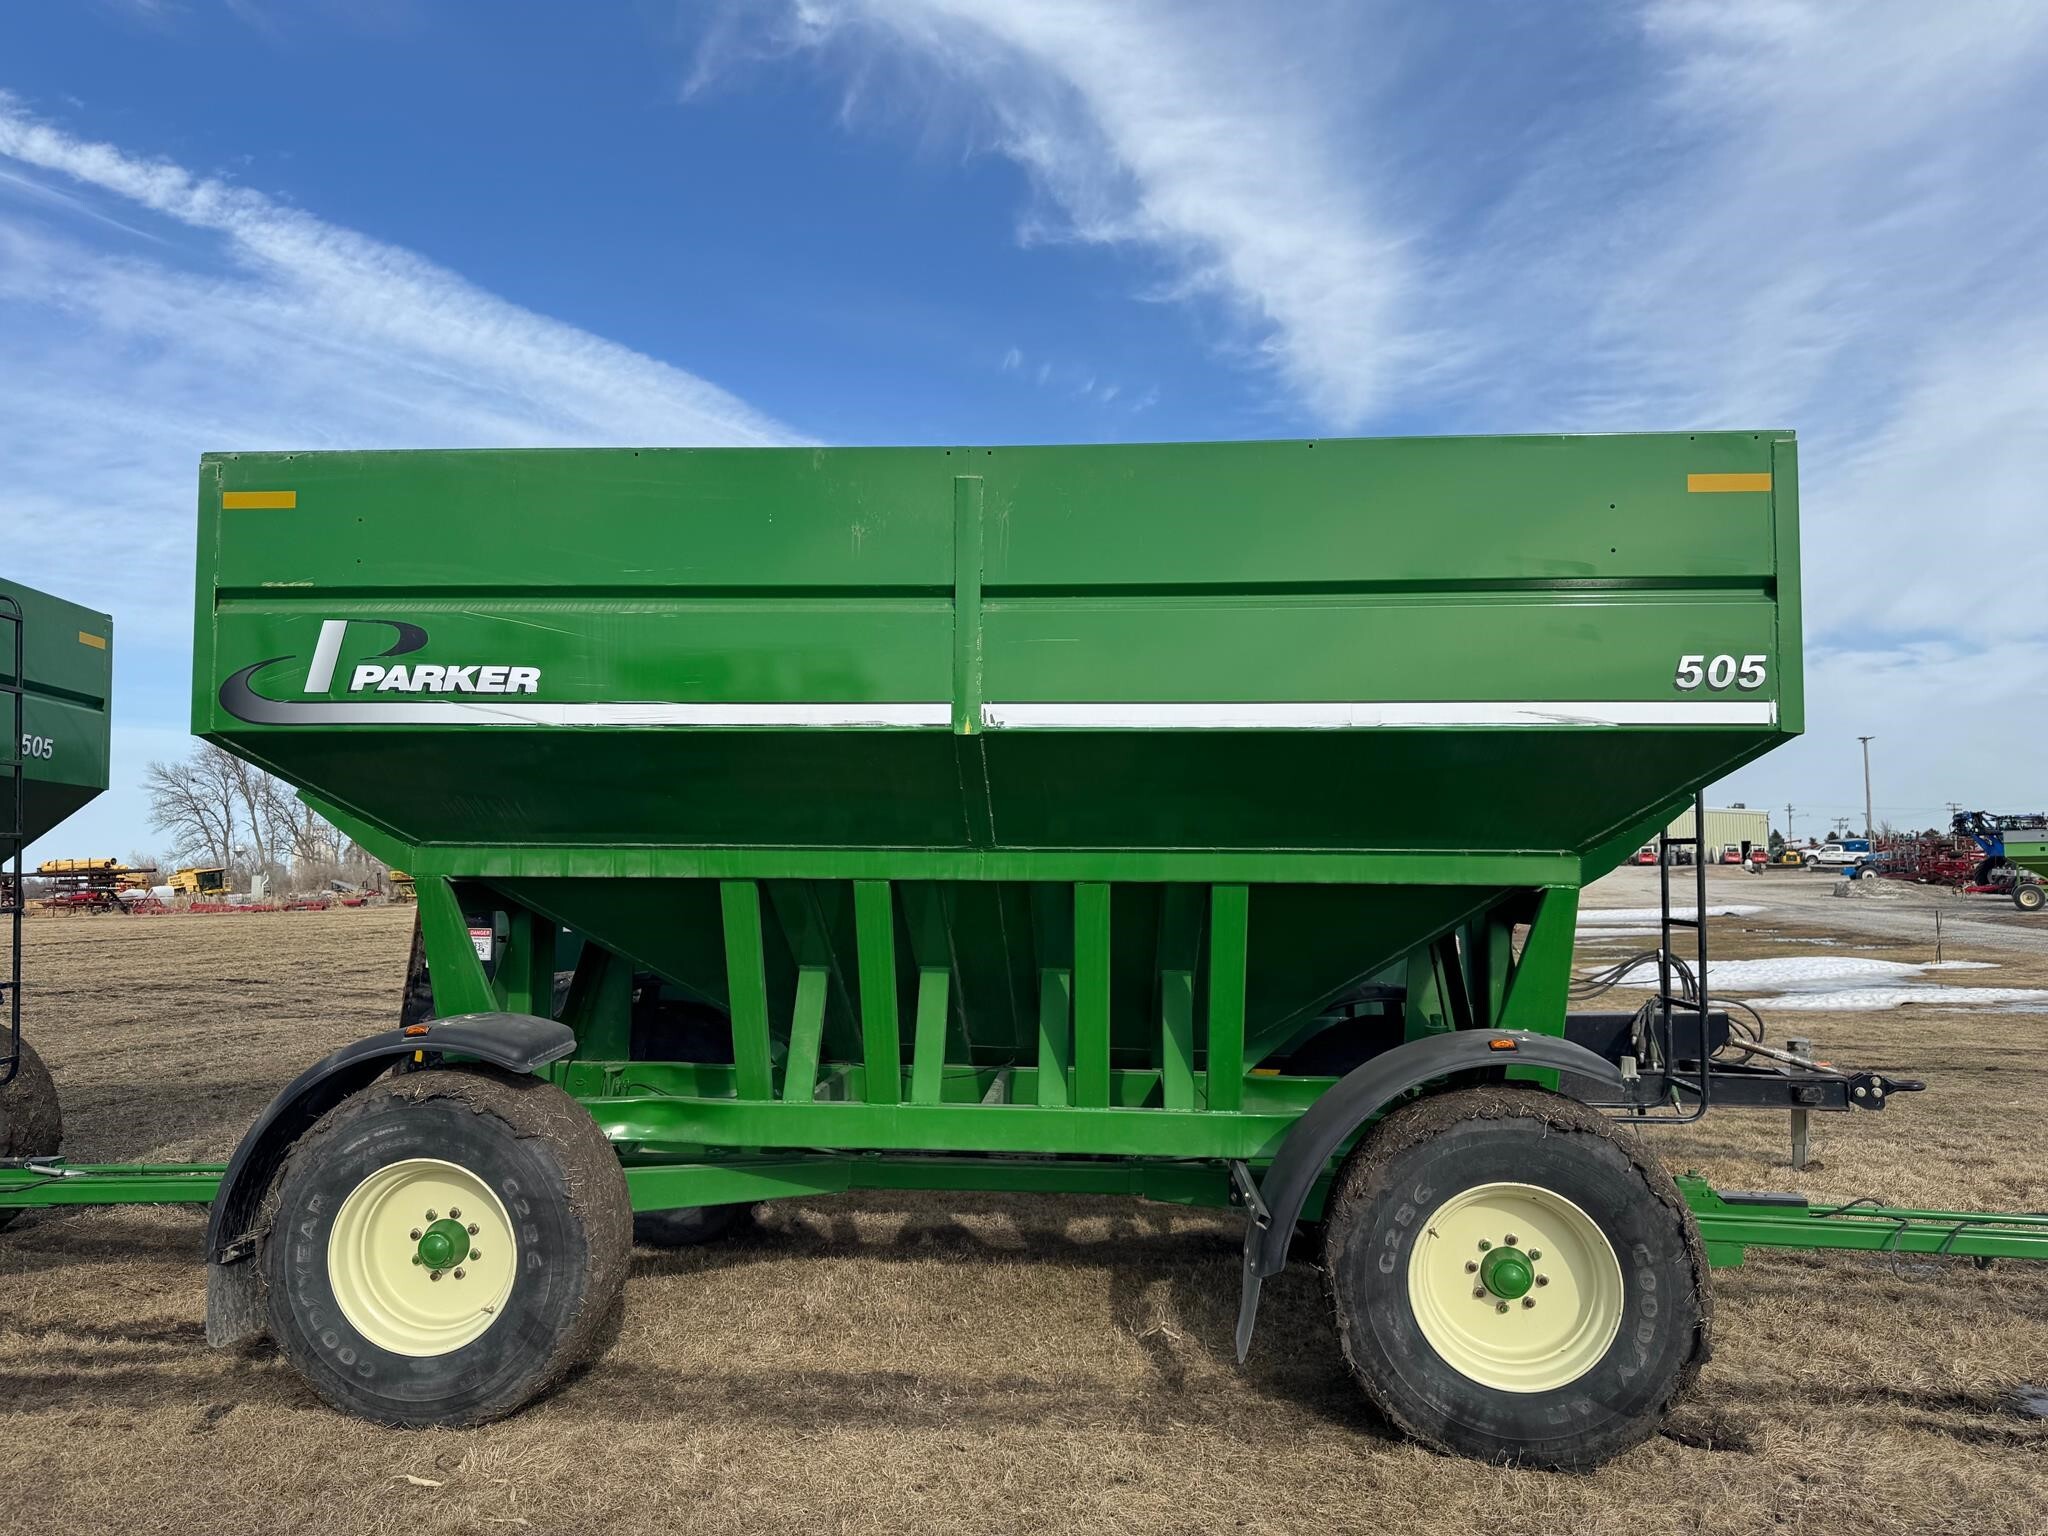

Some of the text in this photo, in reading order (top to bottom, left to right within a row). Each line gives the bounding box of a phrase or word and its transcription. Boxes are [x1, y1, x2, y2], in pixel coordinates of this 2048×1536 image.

[349, 664, 542, 694] PARKER
[1674, 654, 1767, 690] 505
[22, 733, 54, 759] 505
[1379, 1182, 1434, 1274] G286
